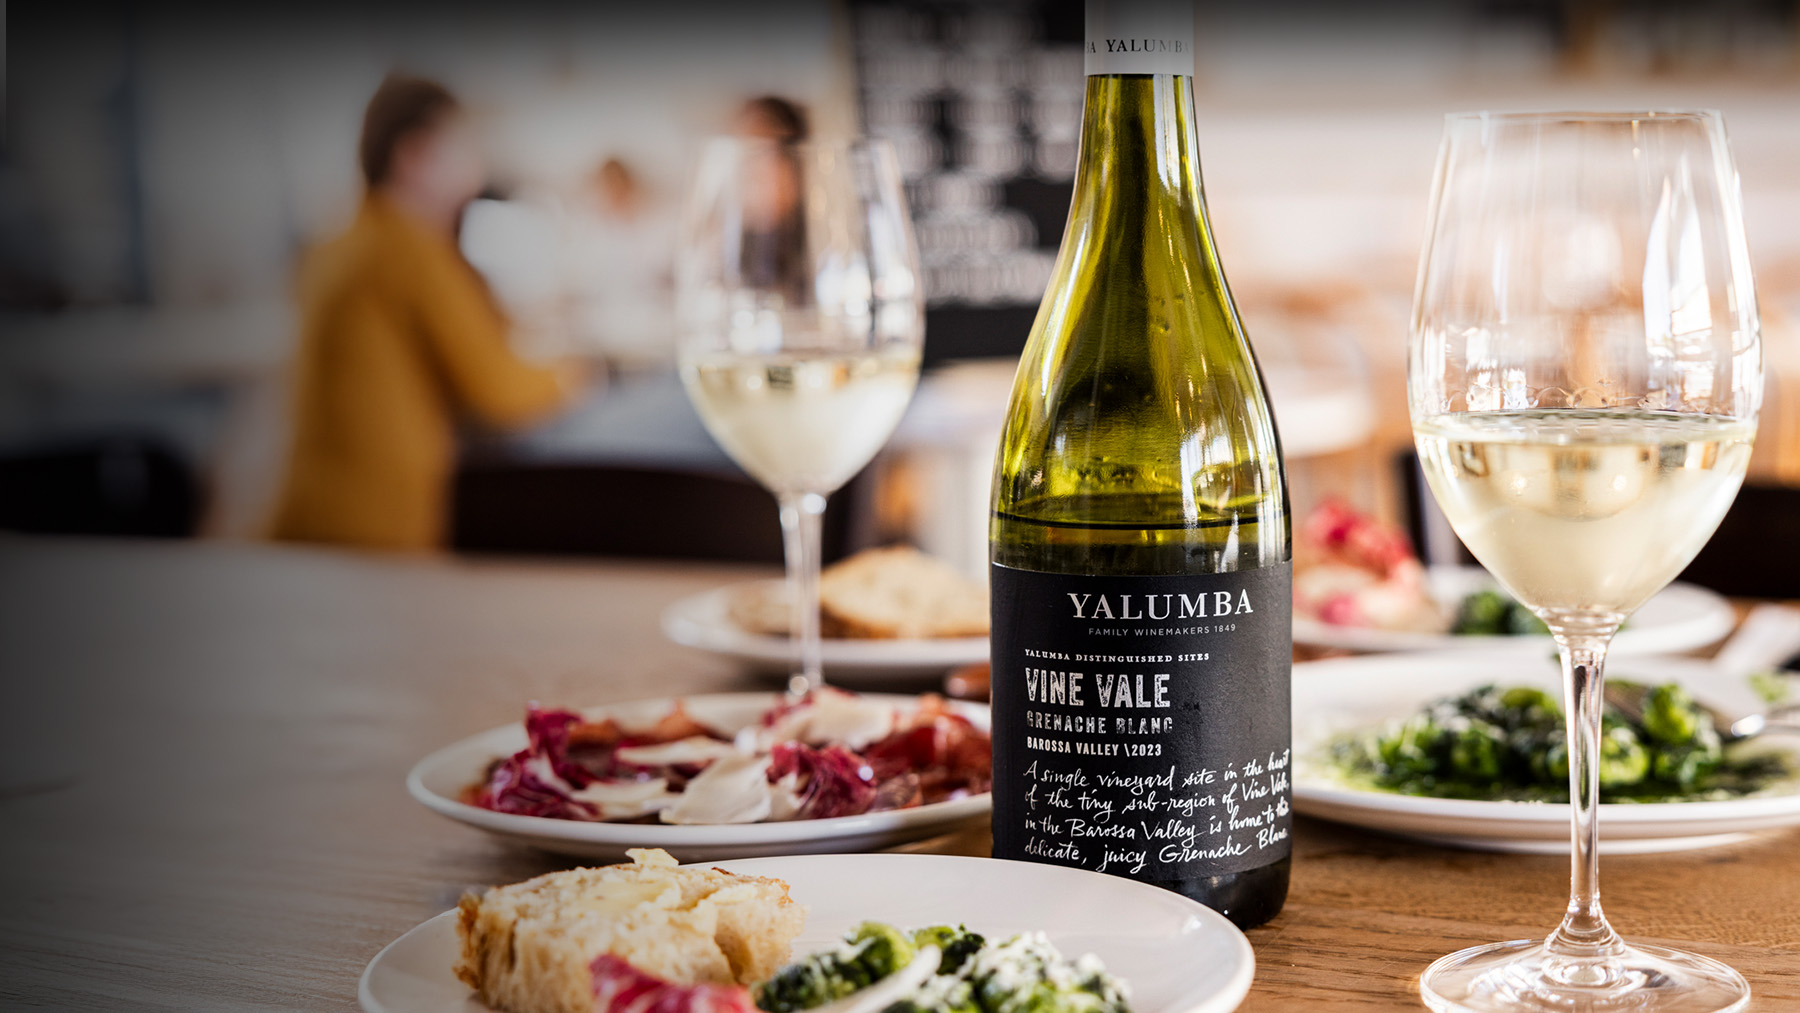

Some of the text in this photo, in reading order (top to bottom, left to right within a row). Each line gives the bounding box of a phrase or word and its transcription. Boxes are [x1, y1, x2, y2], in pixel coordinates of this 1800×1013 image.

[1067, 588, 1253, 620] YALUMBA
[1088, 624, 1236, 637] FAMILY WINEMAKERS 1849
[1025, 649, 1210, 663] YALUMBA DISTINGUISHED SITES
[1025, 667, 1171, 708] VINE VALE
[1026, 710, 1173, 734] GRENACHE BLANC
[1027, 736, 1071, 754] BAROSSA
[1076, 742, 1119, 756] VALLEY
[1023, 760, 1037, 780] A
[1040, 768, 1090, 791] single
[1097, 765, 1175, 795] vineyard
[1182, 768, 1217, 788] site
[1224, 762, 1237, 781] in
[1243, 759, 1263, 777] the
[1025, 783, 1038, 810] of
[1045, 787, 1074, 809] the
[1077, 789, 1116, 824] tiny
[1222, 783, 1238, 814] of
[1242, 778, 1270, 801] Vine
[1025, 812, 1037, 830] in
[1039, 815, 1064, 835] the
[1065, 818, 1136, 840] Barossa
[1141, 819, 1206, 848] Valley
[1209, 815, 1222, 835] is
[1228, 805, 1263, 831] home
[1262, 803, 1275, 824] to
[1096, 844, 1150, 874] juicy
[1159, 835, 1253, 863] Grenache
